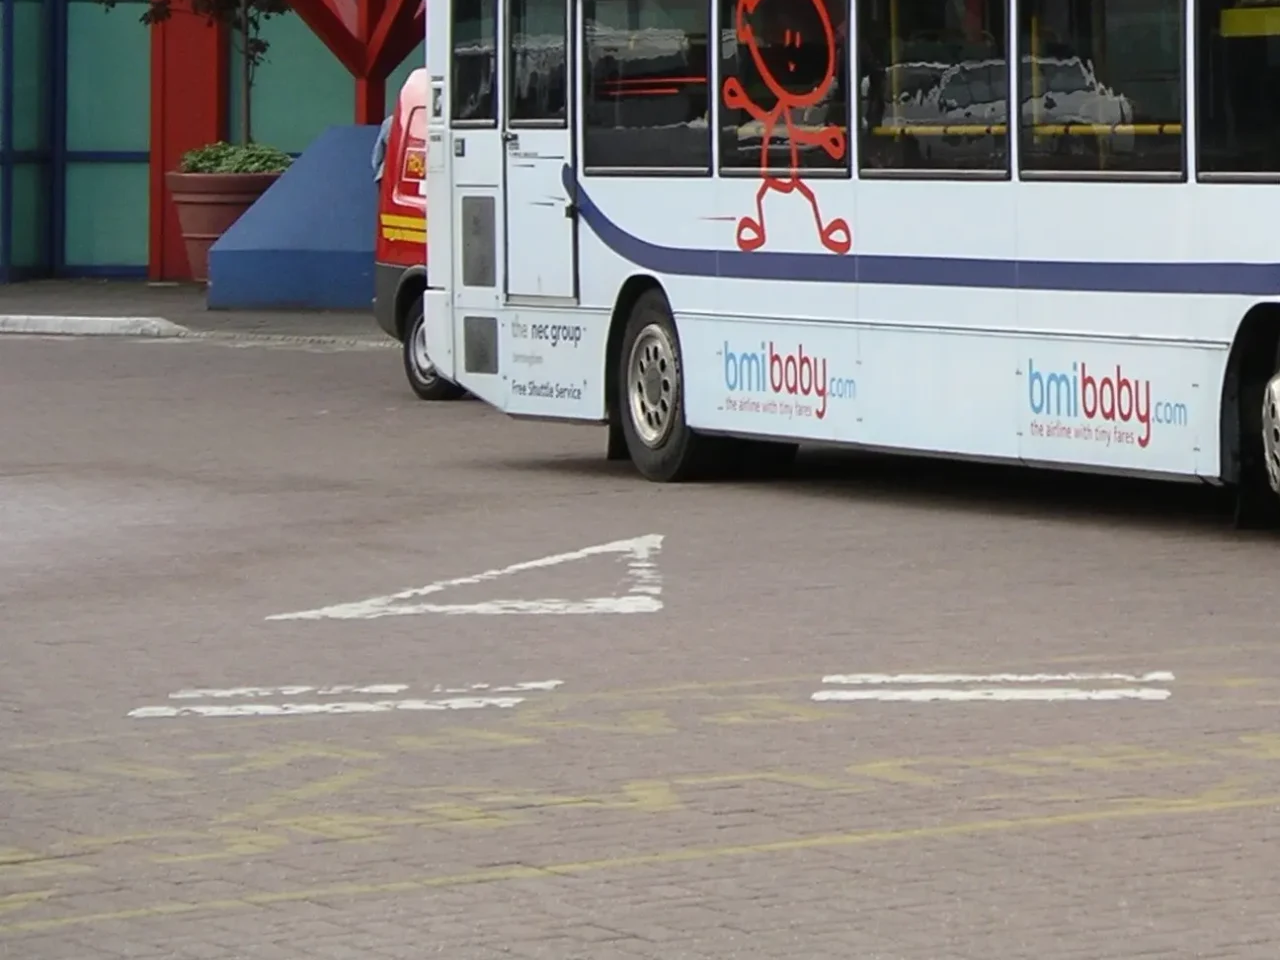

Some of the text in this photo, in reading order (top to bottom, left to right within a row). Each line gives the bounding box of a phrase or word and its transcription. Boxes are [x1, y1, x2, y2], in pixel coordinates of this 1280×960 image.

[511, 314, 582, 349] the nec group
[512, 379, 526, 396] Free
[555, 383, 582, 400] Service
[1030, 420, 1045, 437] the
[1046, 421, 1072, 439] airline
[1113, 426, 1135, 445] fares
